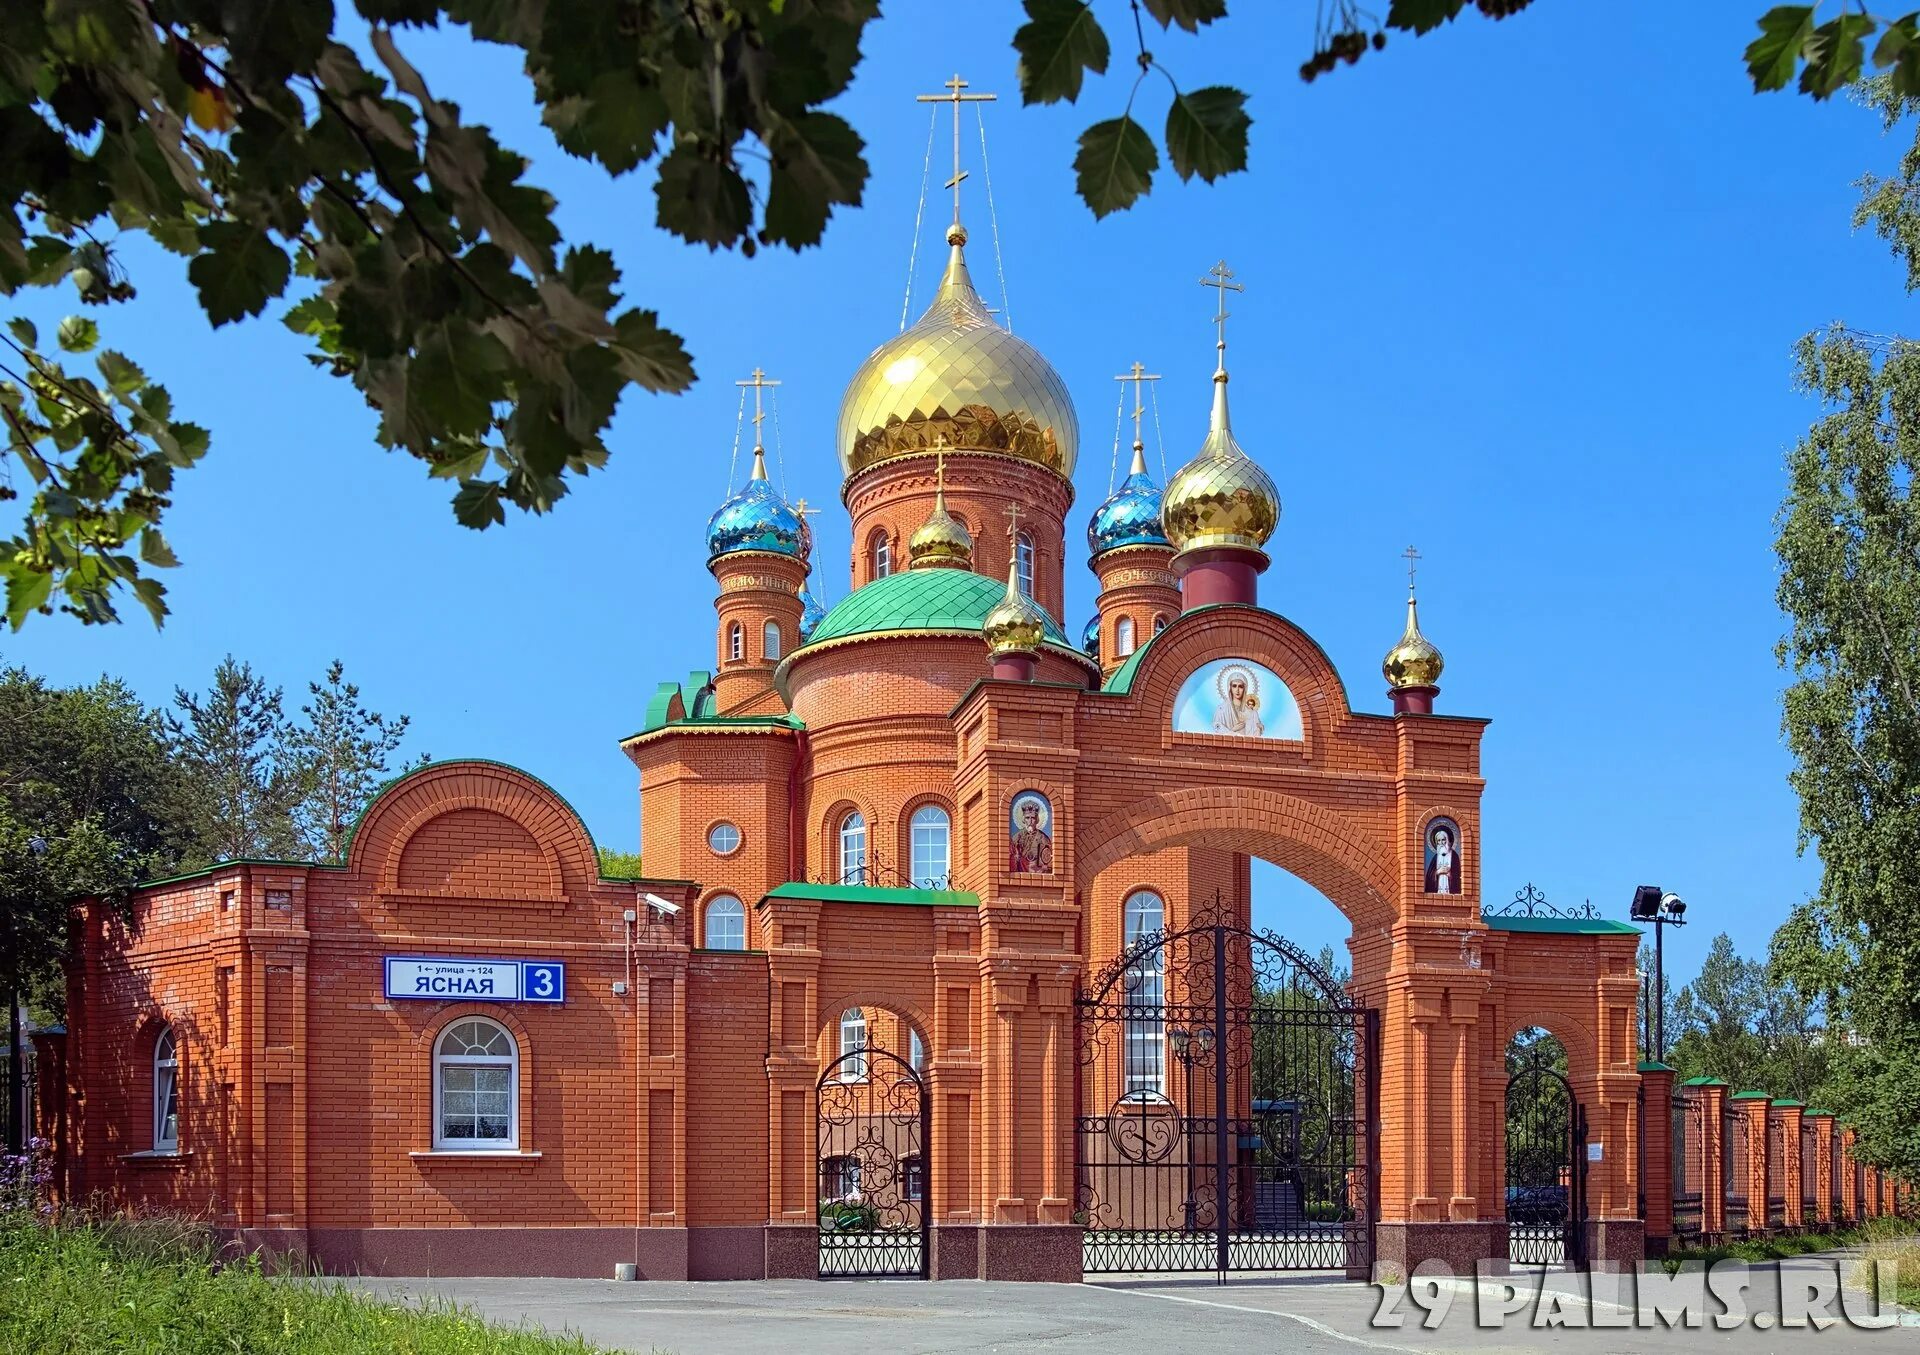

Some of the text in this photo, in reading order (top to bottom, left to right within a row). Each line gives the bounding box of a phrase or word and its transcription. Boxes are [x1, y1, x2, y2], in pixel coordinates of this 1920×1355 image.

[416, 965, 493, 975] 1 улица 124
[415, 976, 494, 994] ЯСНАЯ
[533, 968, 554, 997] 3
